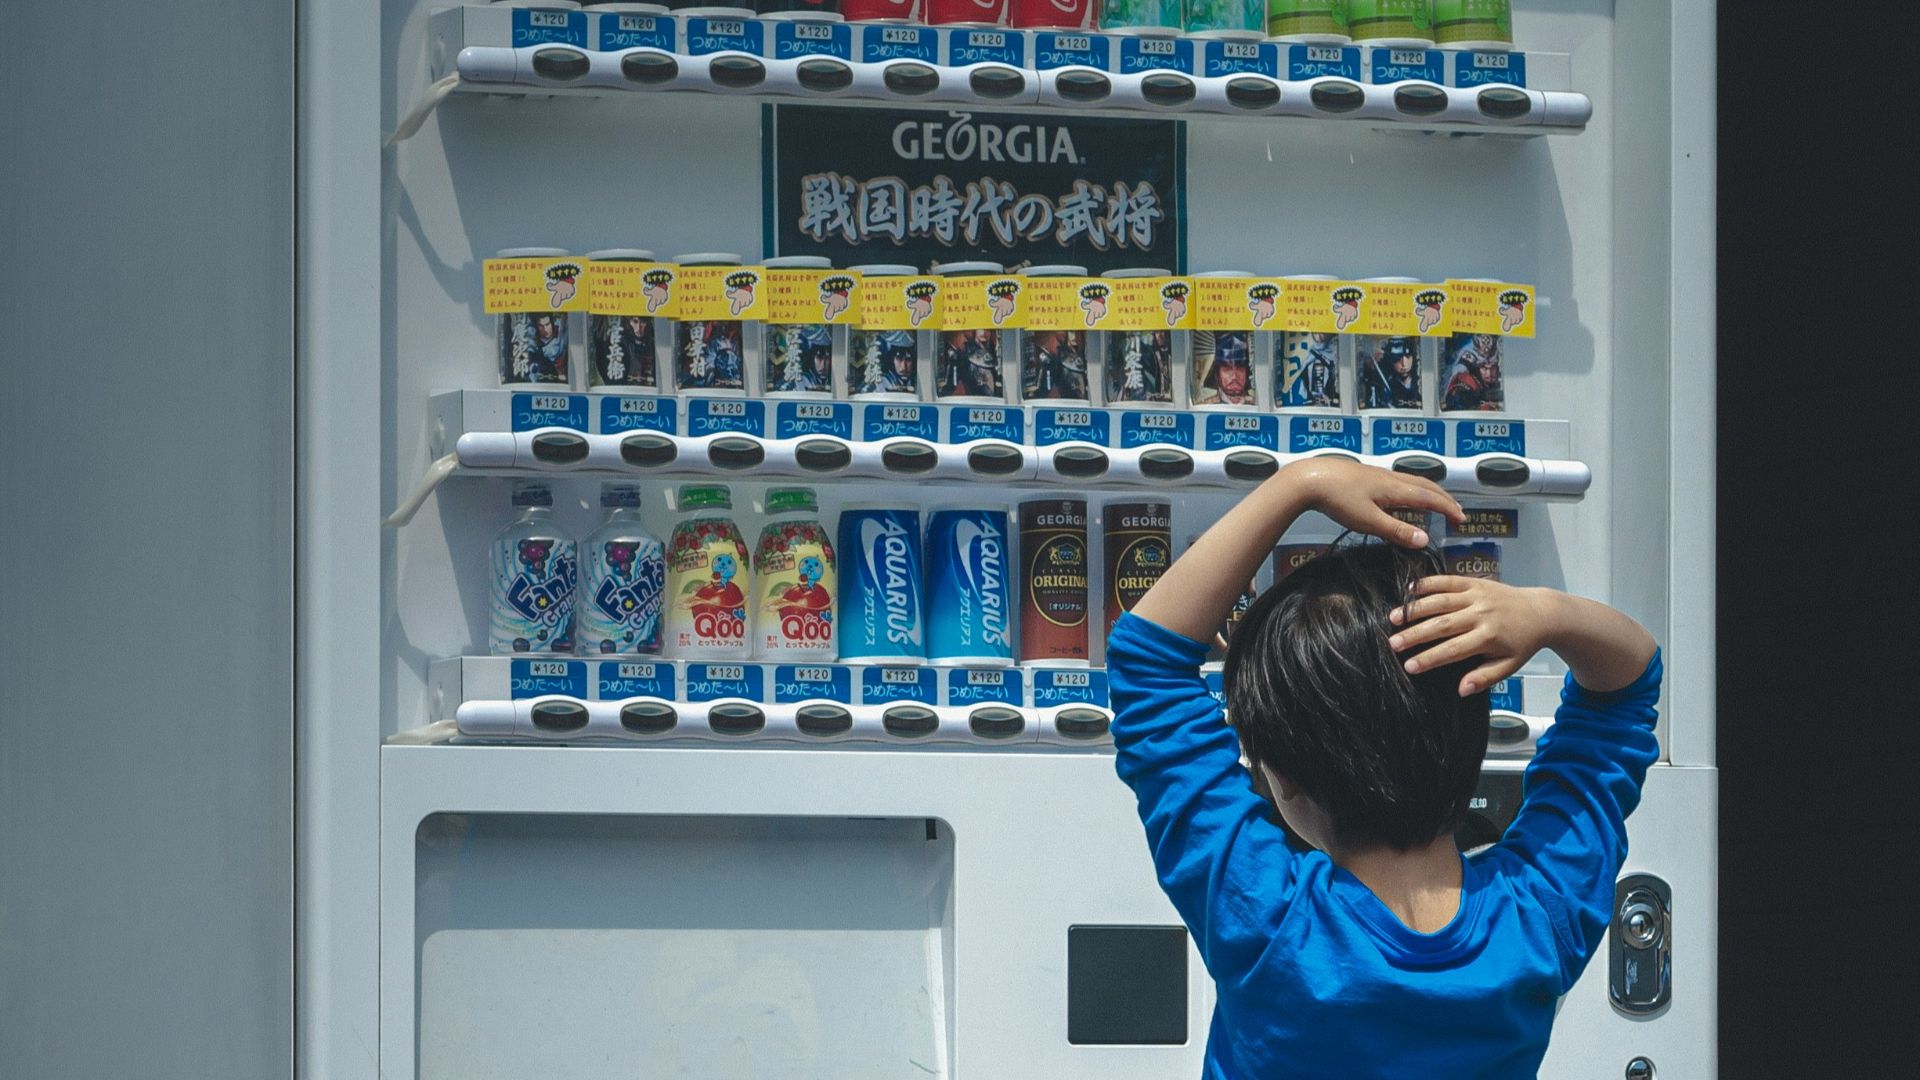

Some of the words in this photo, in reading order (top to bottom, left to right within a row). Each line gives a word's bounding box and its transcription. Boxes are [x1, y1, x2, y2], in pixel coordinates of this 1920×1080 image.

[535, 12, 566, 24] ¥120
[623, 16, 654, 28] ¥120
[711, 22, 742, 33] ¥120
[799, 26, 830, 37] ¥120
[887, 28, 918, 40] ¥120
[973, 32, 1004, 44] ¥120
[1058, 36, 1088, 48] ¥120
[1143, 40, 1173, 52] ¥120
[1227, 44, 1256, 56] ¥120
[1311, 48, 1340, 59] ¥120
[1394, 50, 1423, 62] ¥120
[1478, 54, 1507, 65] ¥120
[892, 110, 1077, 164] GEORGIA
[800, 173, 1164, 249] 戦国時代の武将
[535, 397, 566, 408] ¥120
[624, 399, 655, 410] ¥120
[712, 402, 743, 413] ¥120
[800, 405, 831, 416] ¥120
[887, 407, 917, 418] ¥120
[973, 410, 1003, 421] ¥120
[1059, 412, 1090, 423] ¥120
[1144, 414, 1174, 425] ¥120
[1228, 417, 1257, 428] ¥120
[1312, 419, 1341, 430] ¥120
[1395, 421, 1424, 432] ¥120
[1479, 423, 1507, 434] ¥120
[885, 518, 908, 645] AQUARIUS
[980, 520, 1000, 646] AQUARIUS
[506, 554, 577, 622] Fanta
[595, 556, 665, 624] Fanta
[864, 586, 875, 646] アクエリアス
[960, 588, 971, 646] アクエリアス
[694, 613, 745, 639] Qoo
[782, 615, 832, 640] Qoo
[534, 662, 565, 674] ¥120
[622, 664, 653, 676] ¥120
[710, 666, 741, 678] ¥120
[798, 668, 829, 680] ¥120
[885, 670, 915, 682] ¥120
[971, 672, 1001, 682] ¥120
[1056, 674, 1086, 684] ¥120
